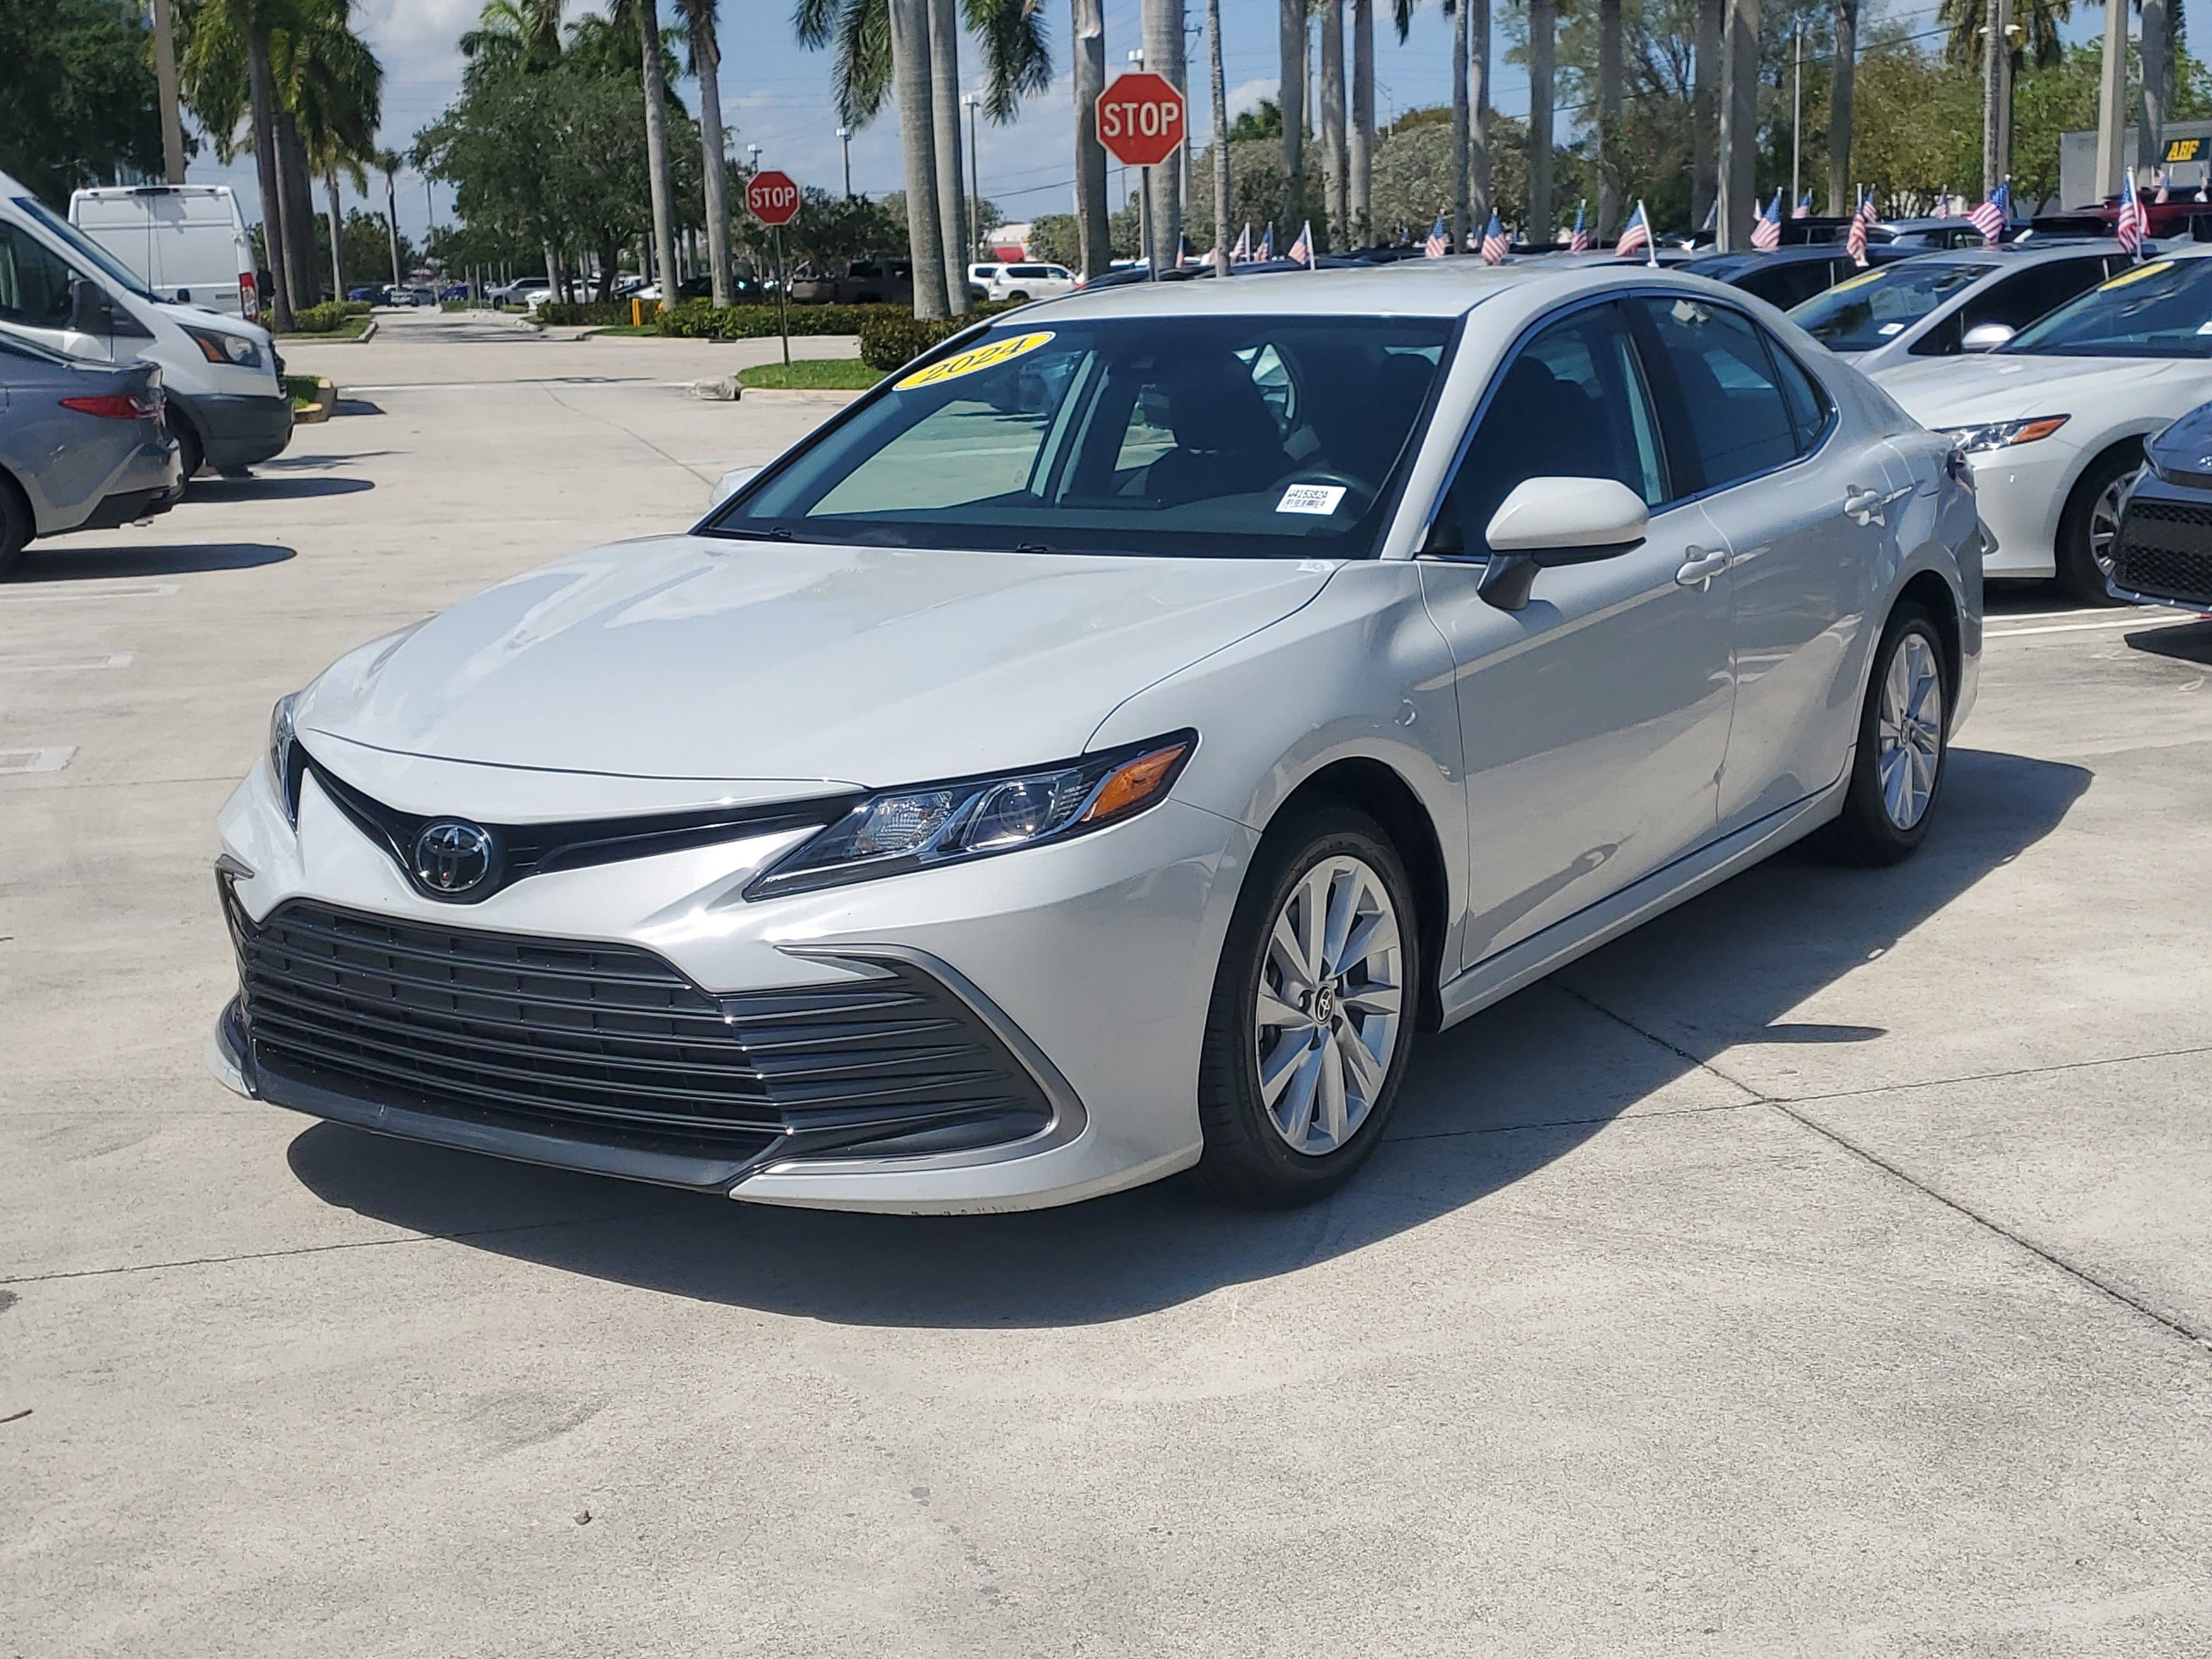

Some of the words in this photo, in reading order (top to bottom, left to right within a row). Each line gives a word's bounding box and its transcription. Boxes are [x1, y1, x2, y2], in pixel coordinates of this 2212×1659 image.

[1103, 101, 1180, 137] STOP
[751, 187, 795, 208] STOP
[918, 337, 1029, 383] 2024
